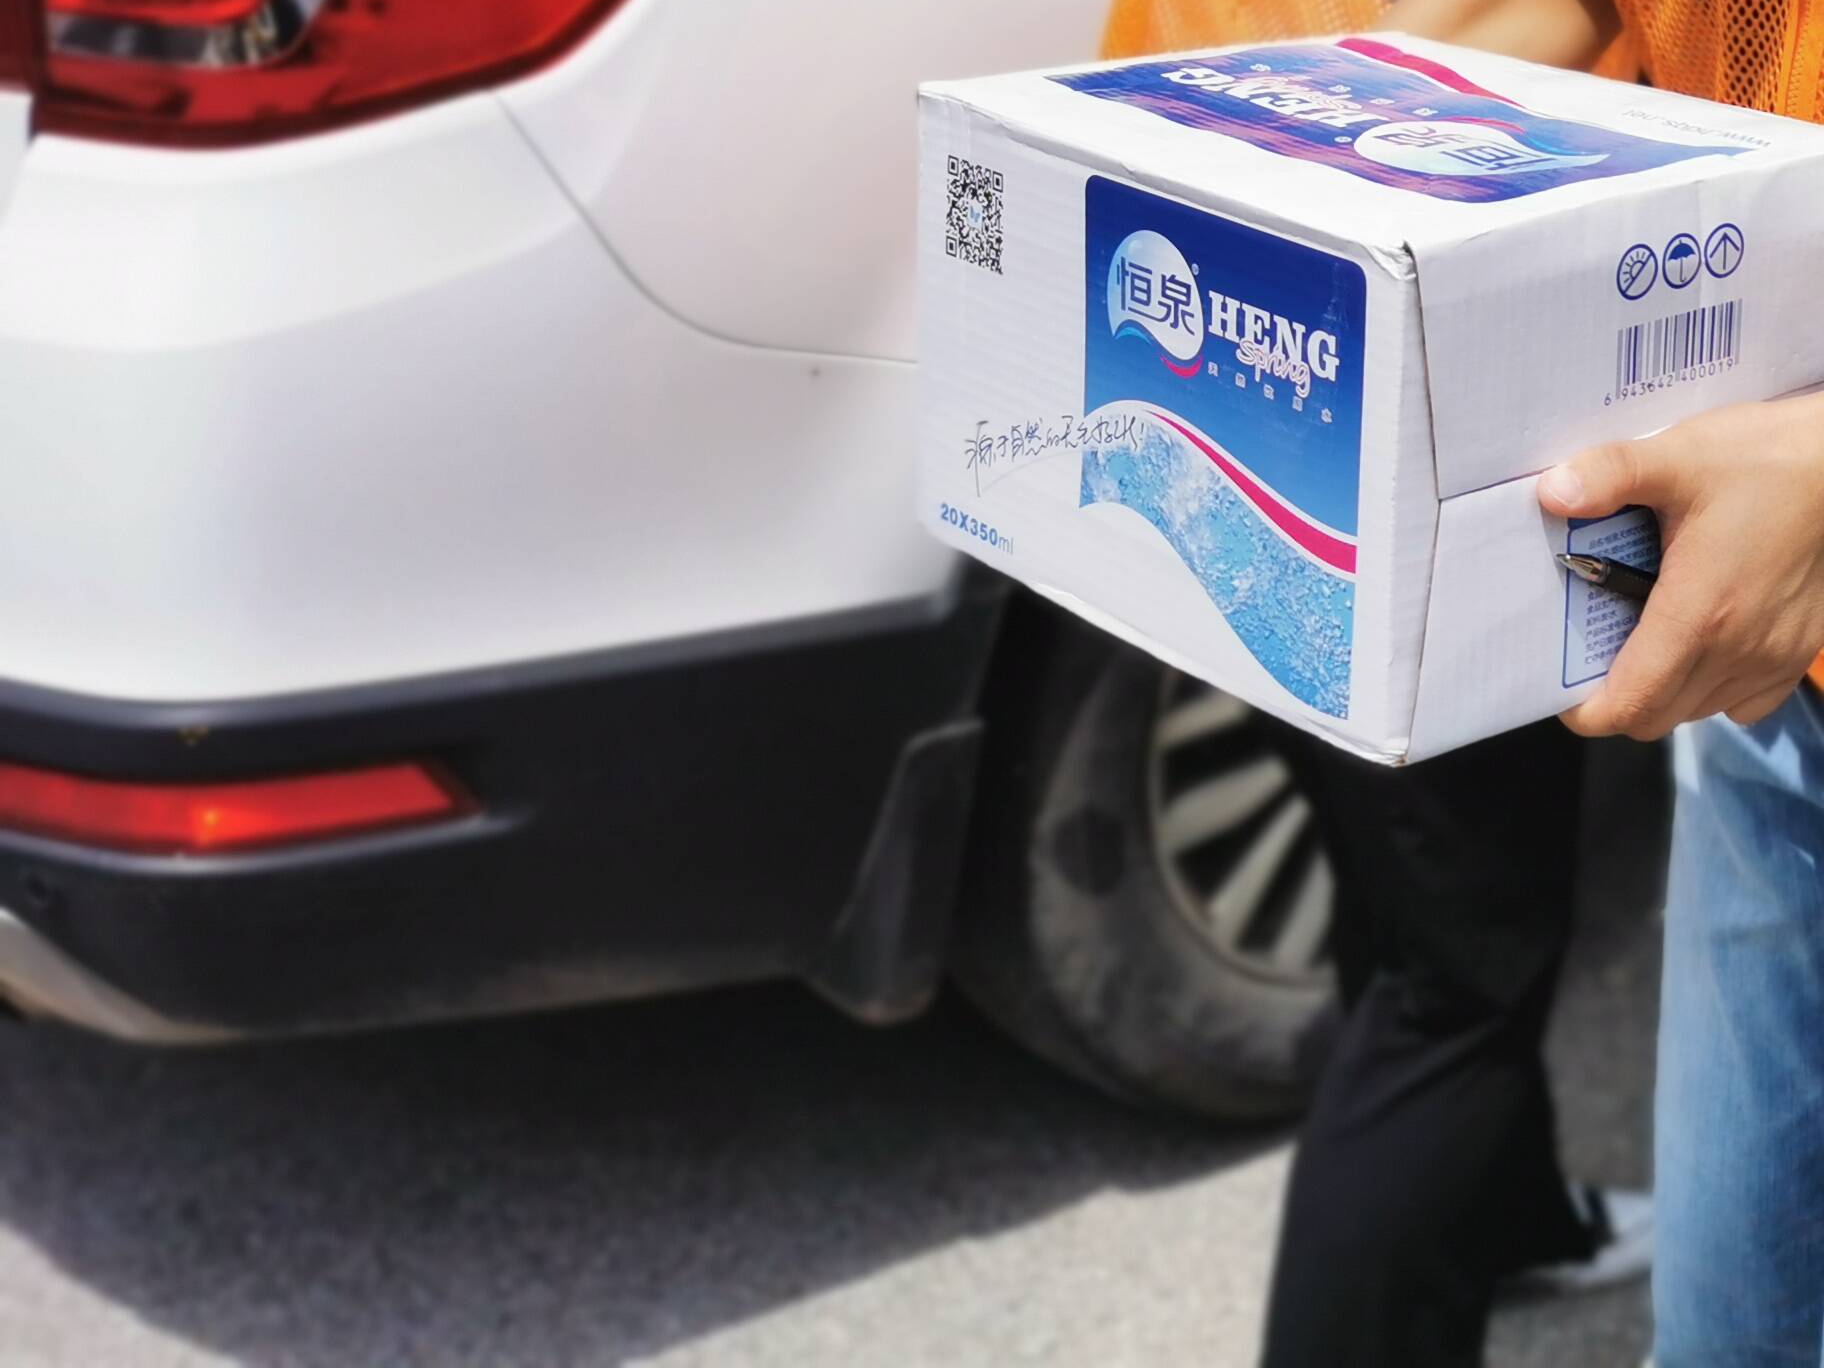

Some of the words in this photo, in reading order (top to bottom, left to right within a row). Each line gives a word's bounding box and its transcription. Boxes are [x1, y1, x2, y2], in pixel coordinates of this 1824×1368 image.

[1115, 255, 1196, 337] 恒泉
[1207, 289, 1340, 382] HENG
[1235, 337, 1311, 399] Spring
[1603, 392, 1612, 406] 6
[1621, 375, 1674, 401] 943642
[1681, 358, 1734, 382] 400019
